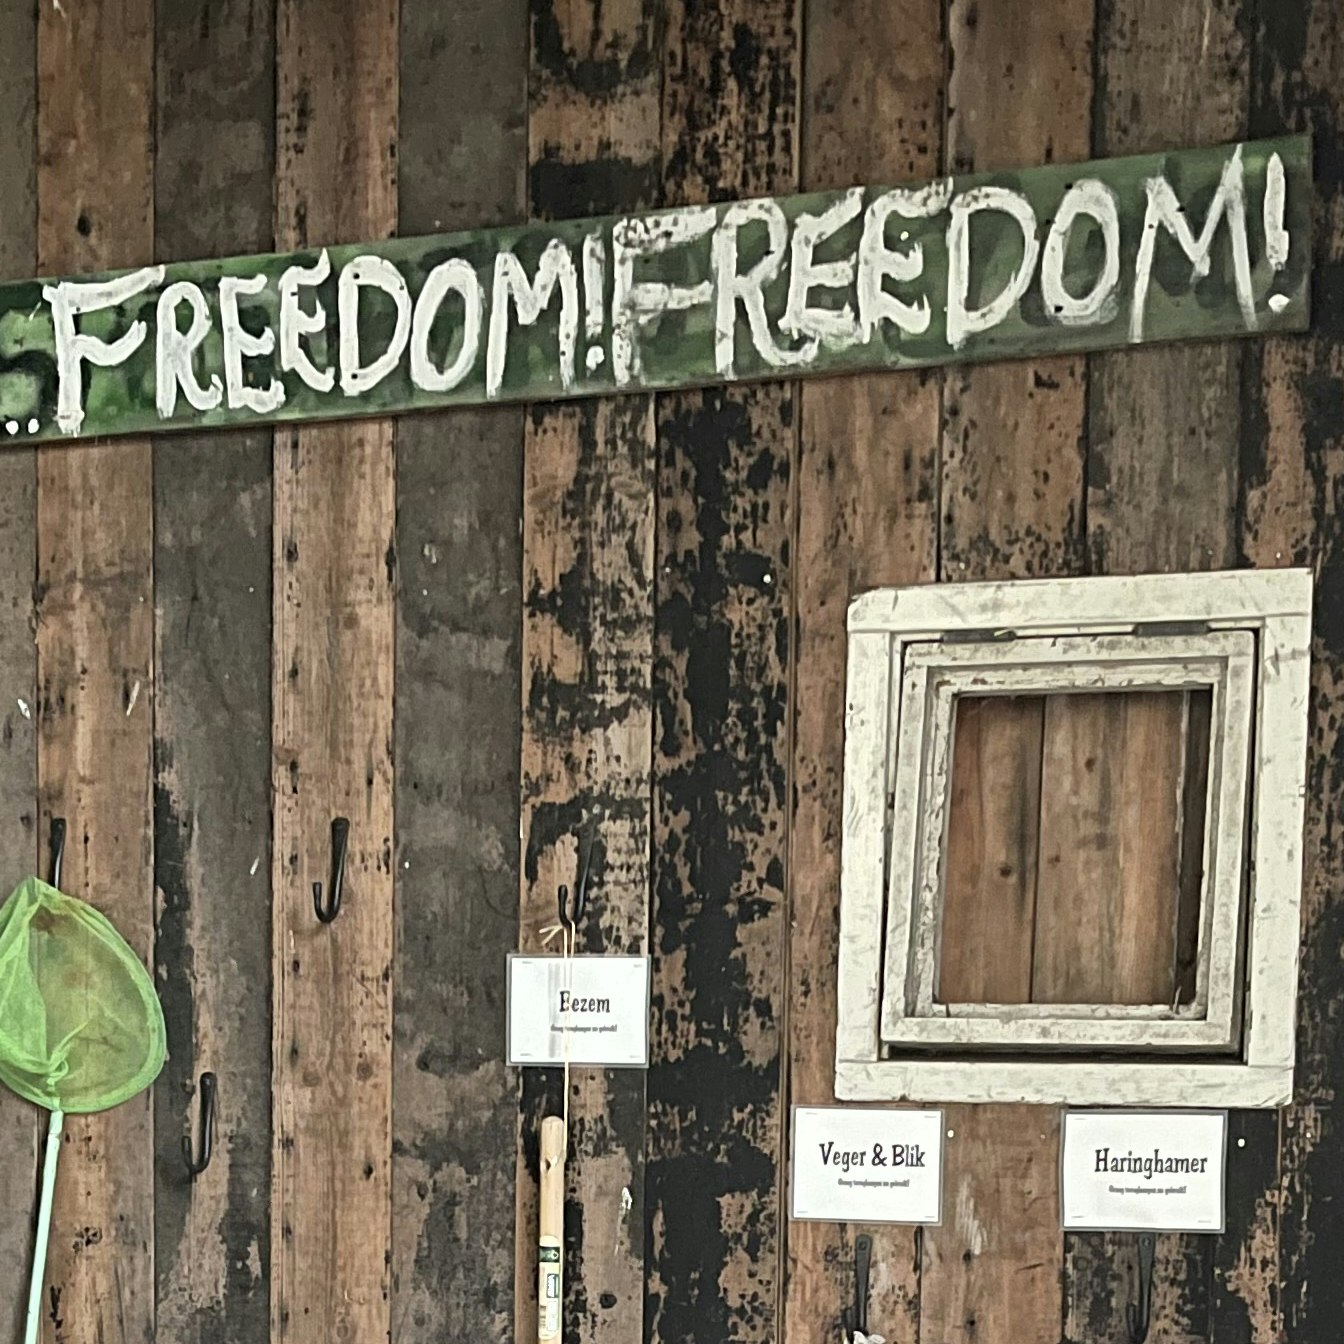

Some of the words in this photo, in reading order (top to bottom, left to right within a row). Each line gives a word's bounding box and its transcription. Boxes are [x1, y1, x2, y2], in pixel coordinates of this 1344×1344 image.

[42, 228, 606, 437] FREEDOM!
[612, 142, 1291, 387] FREEDOM!
[818, 1141, 867, 1173] Veger
[871, 1142, 888, 1167] &
[891, 1143, 926, 1168] Blik
[1094, 1147, 1208, 1180] Haringhamer
